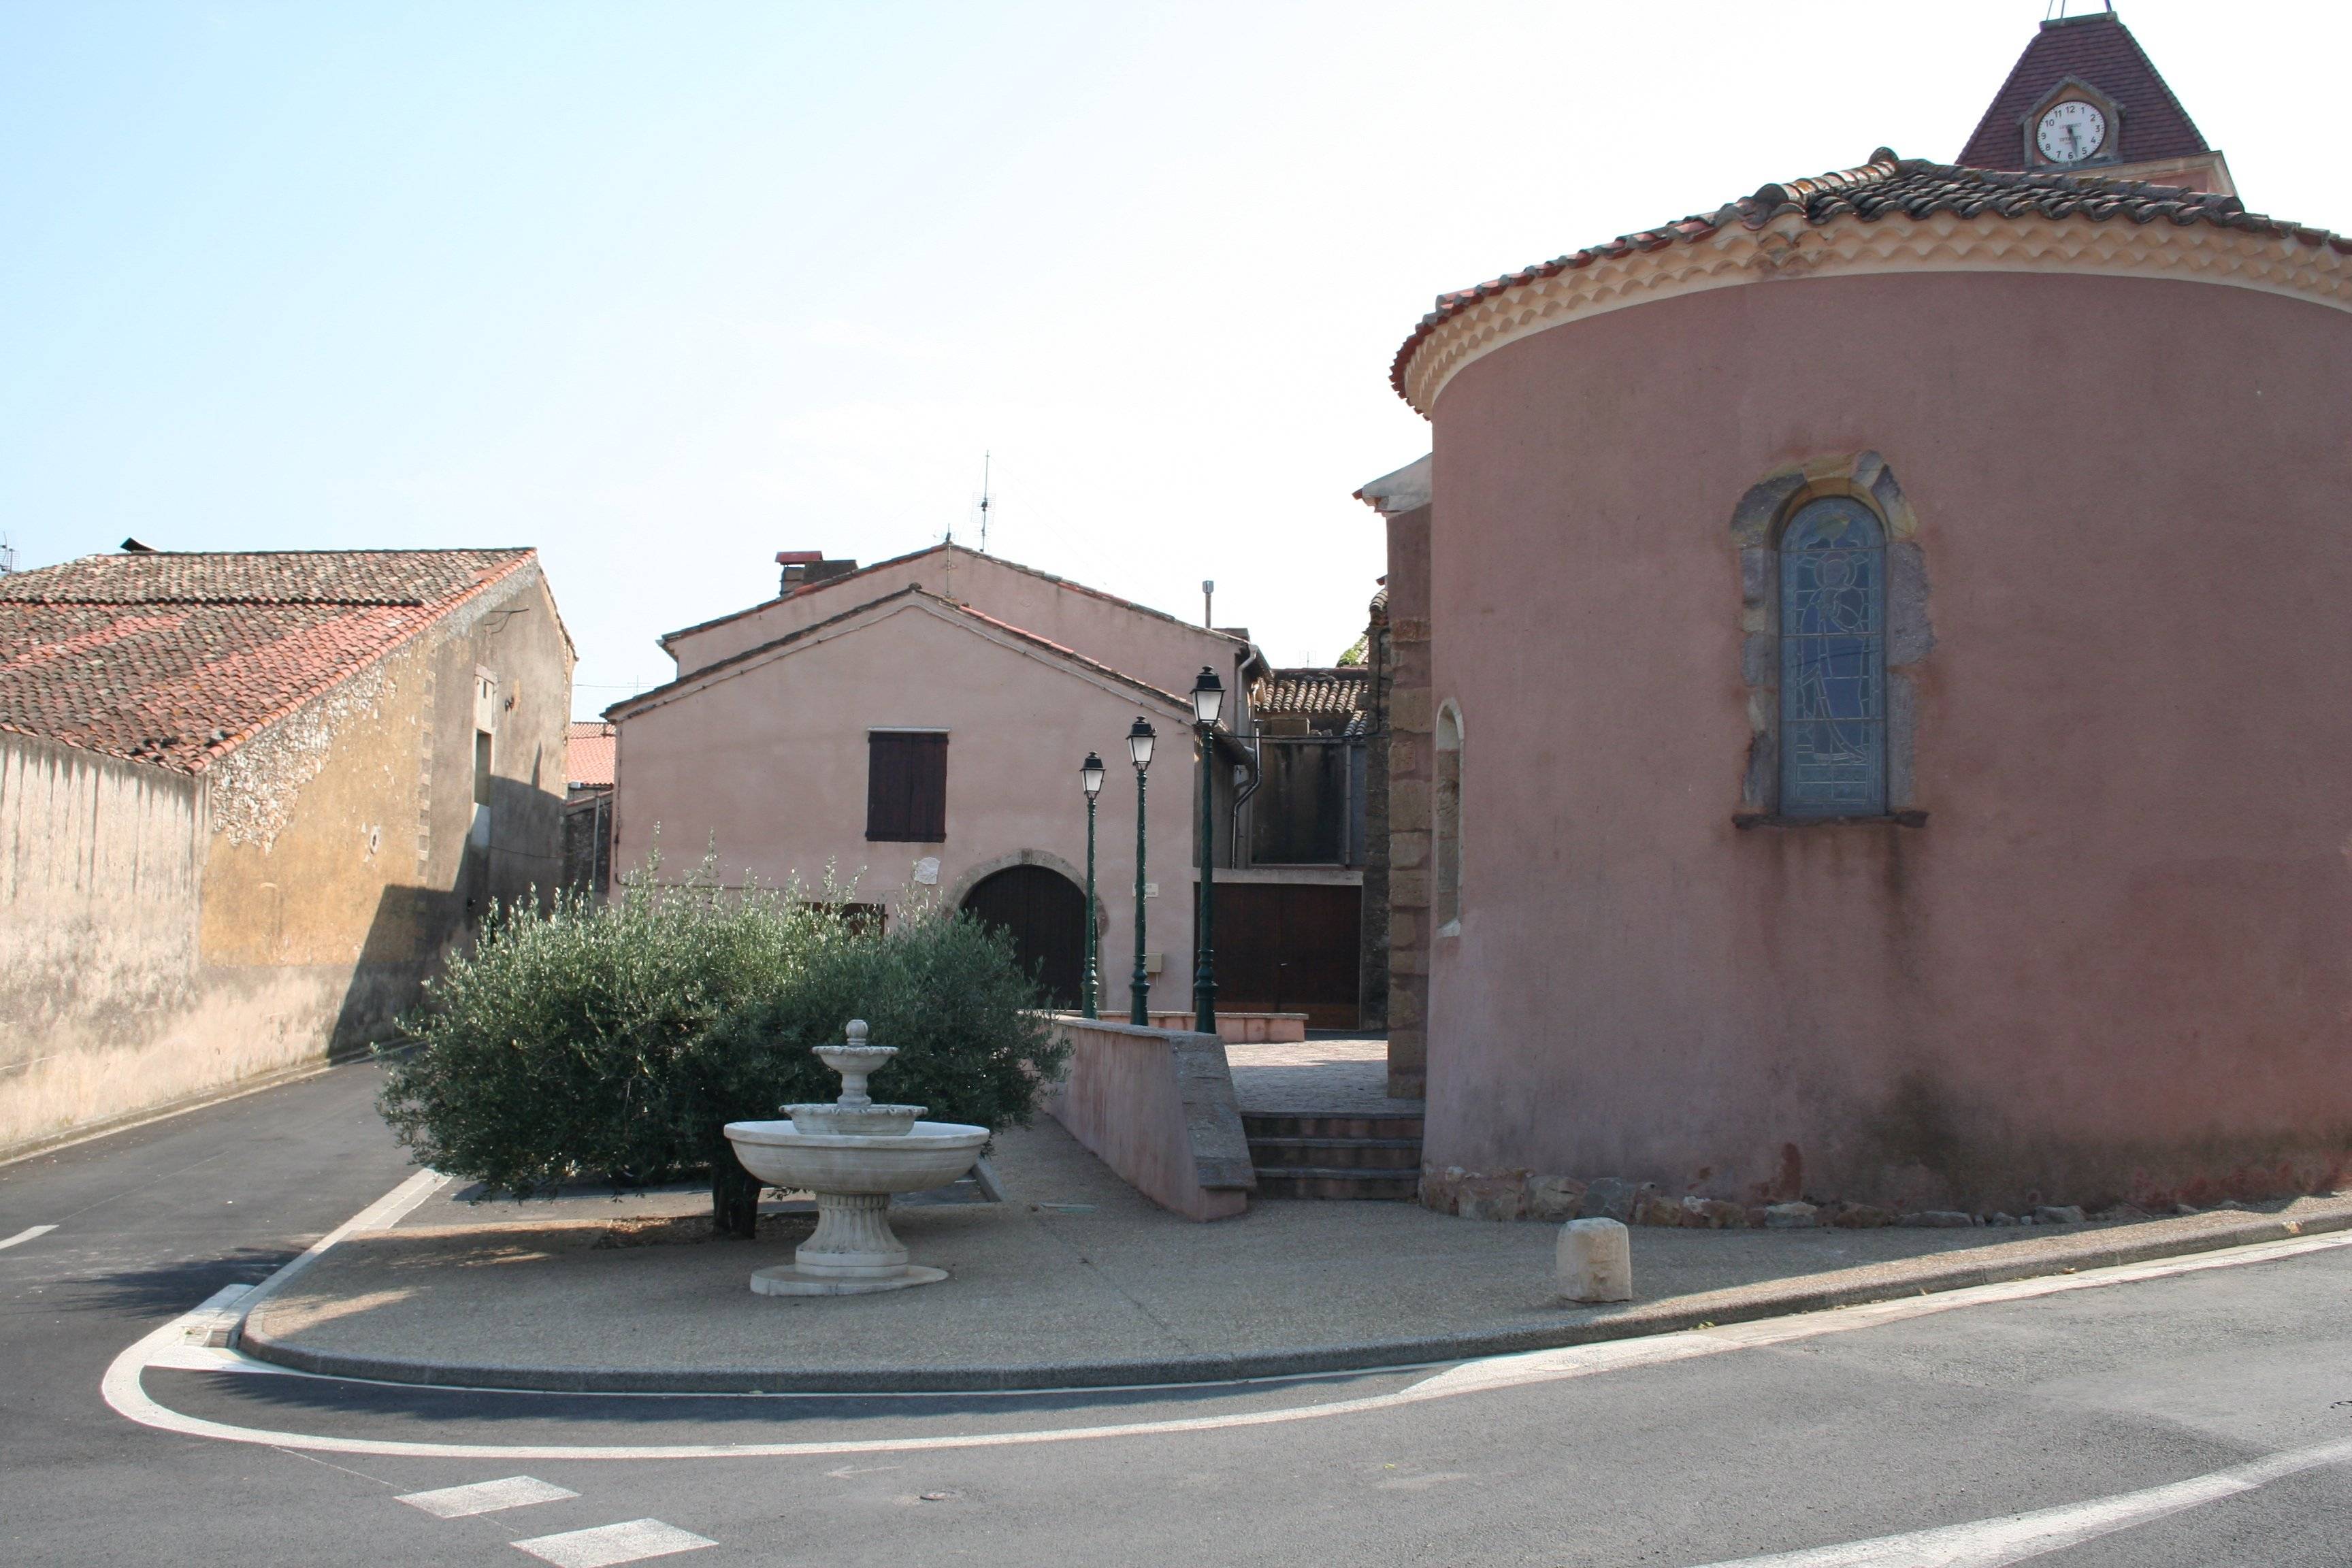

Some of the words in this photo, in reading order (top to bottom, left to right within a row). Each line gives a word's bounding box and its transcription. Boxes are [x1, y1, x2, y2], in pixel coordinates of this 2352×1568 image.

[2065, 105, 2075, 114] 12
[2054, 110, 2061, 118] 11
[2090, 114, 2095, 122] 2
[2044, 119, 2055, 127] 10
[2095, 125, 2100, 133] 3
[2082, 146, 2087, 154] 5
